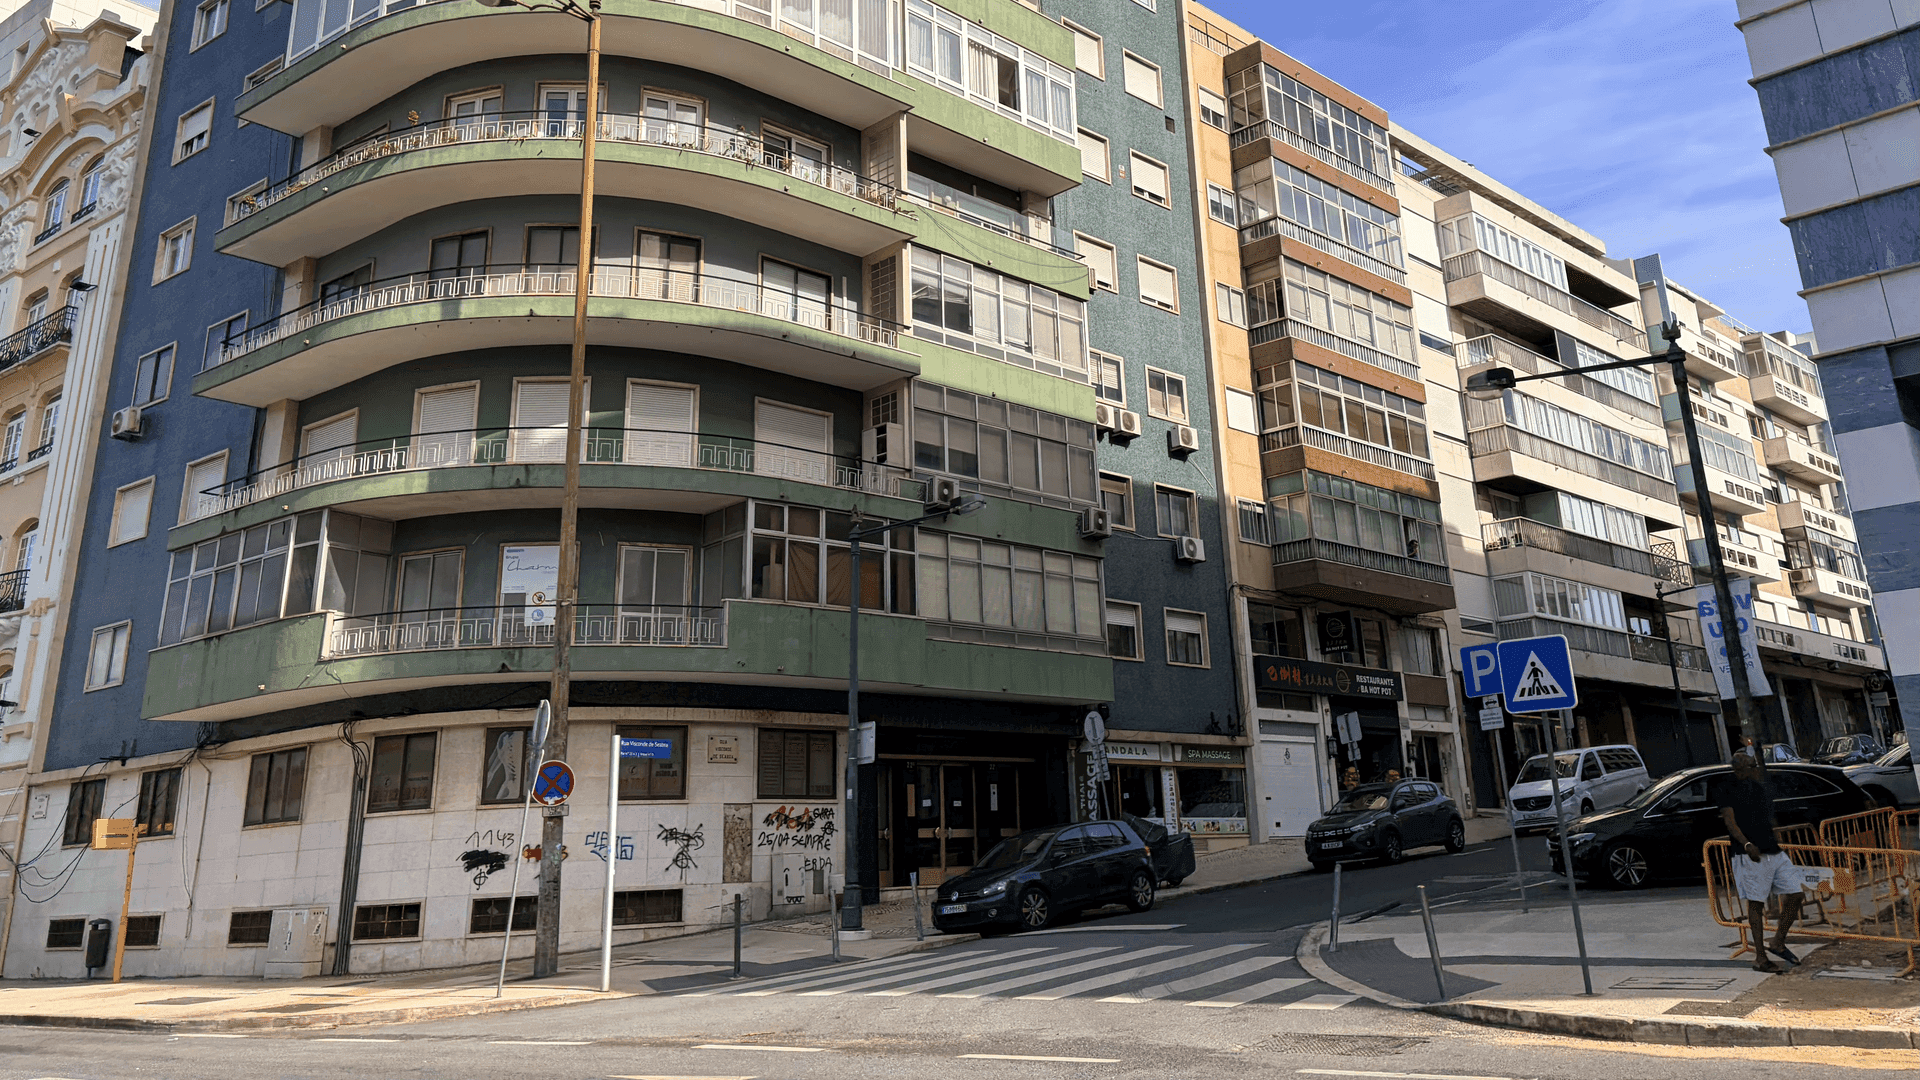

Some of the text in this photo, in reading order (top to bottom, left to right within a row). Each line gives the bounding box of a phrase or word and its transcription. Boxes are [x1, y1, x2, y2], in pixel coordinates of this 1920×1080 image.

[1470, 649, 1495, 692] P
[1356, 674, 1394, 687] RESTAURANTE
[1360, 685, 1392, 696] BA HOT POT
[1105, 745, 1148, 755] ANDALA
[1187, 749, 1231, 760] SPA MASSAGE
[1086, 754, 1098, 821] ASSAGE
[791, 834, 831, 851] SEMPRE
[804, 856, 833, 873] ERDA
